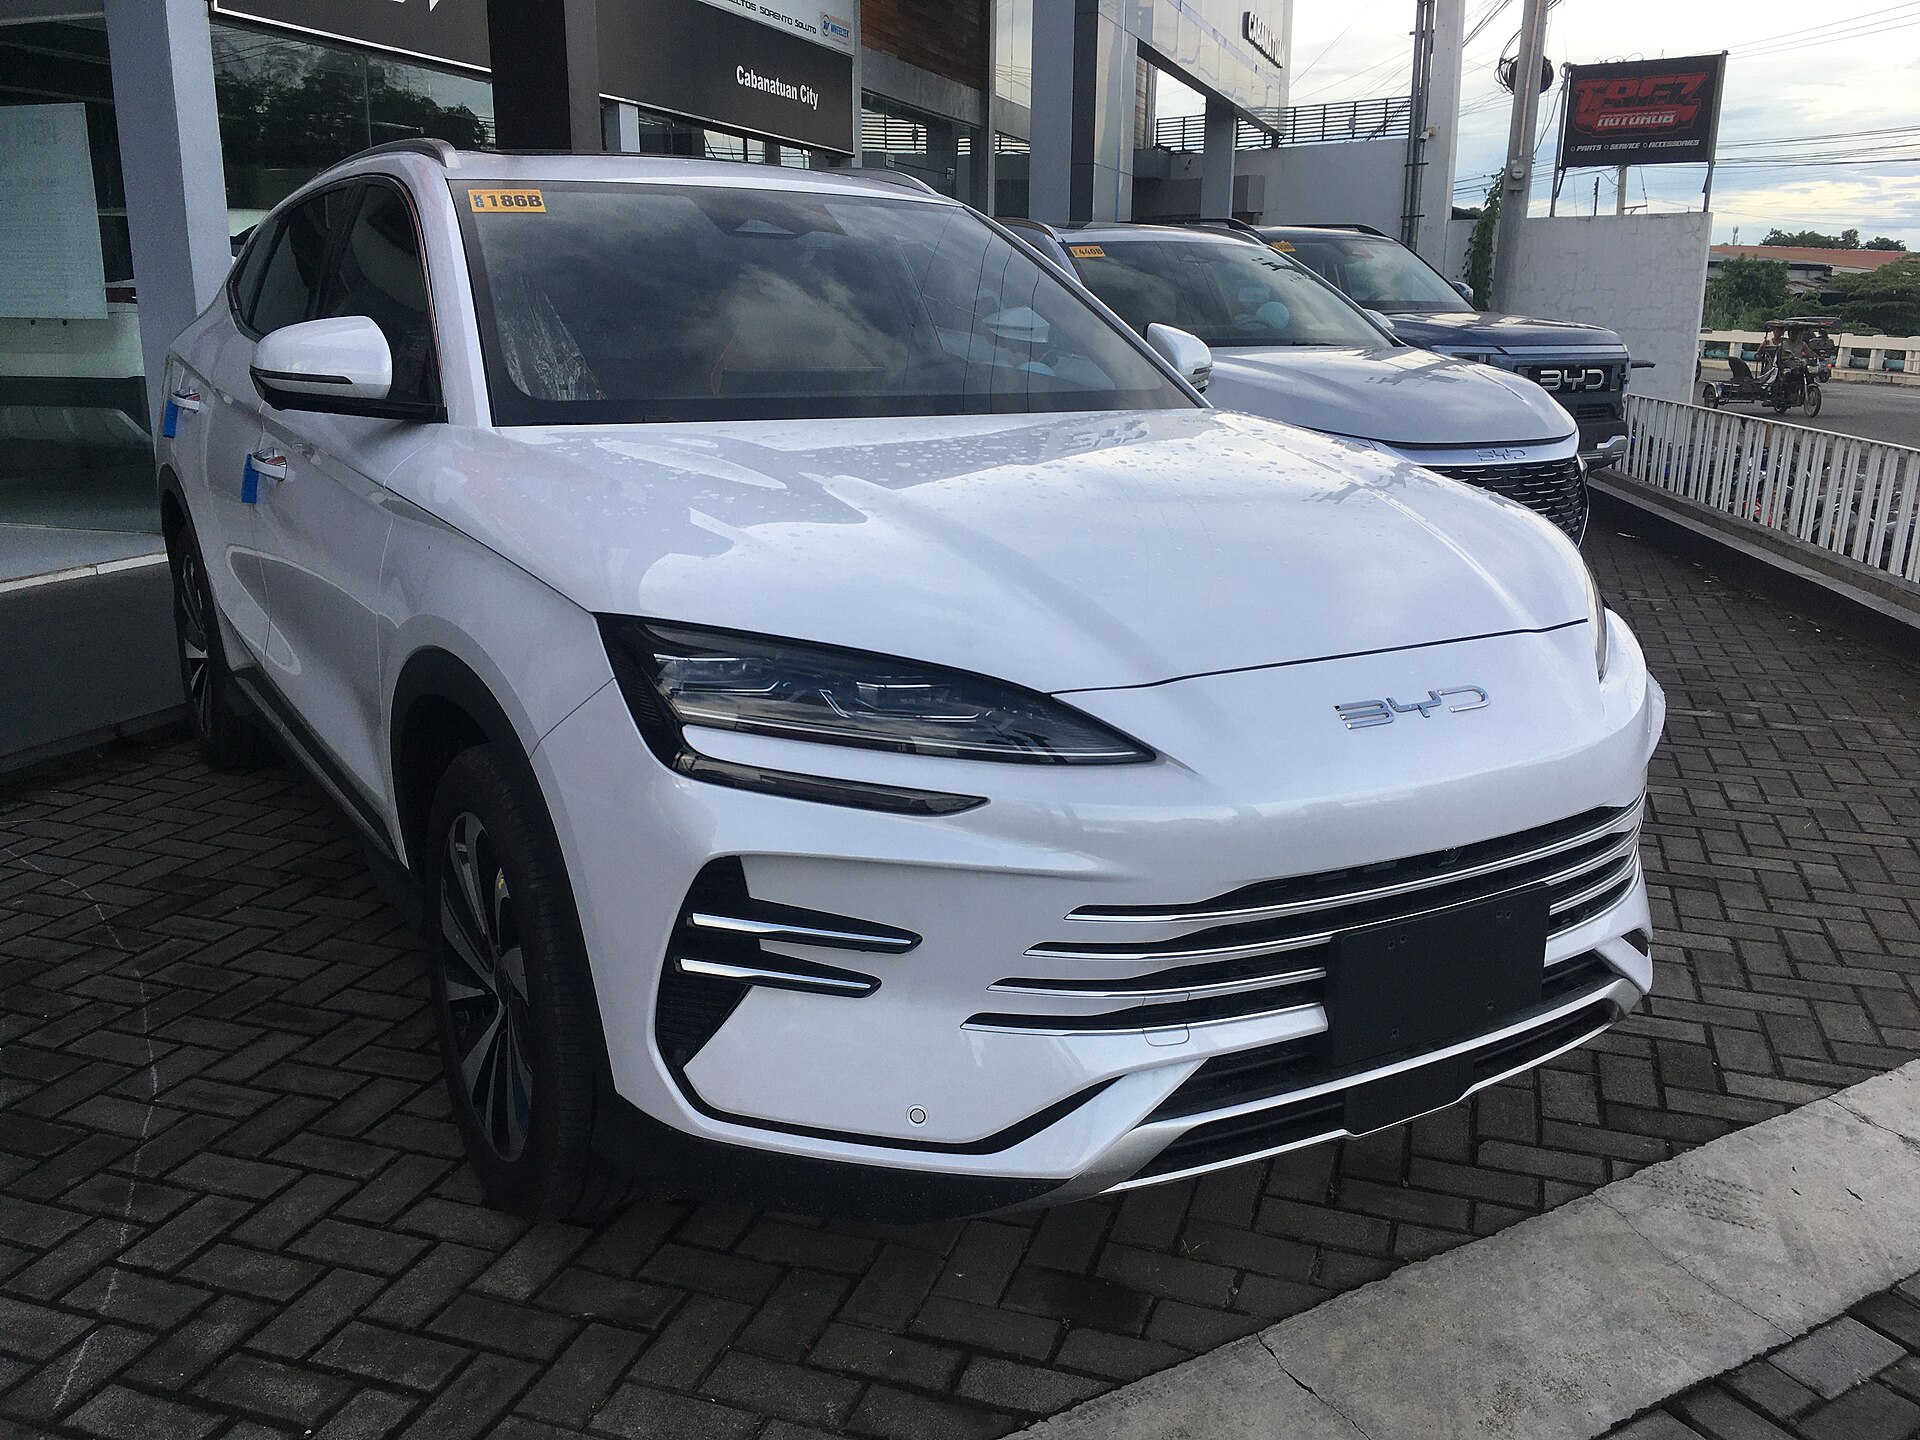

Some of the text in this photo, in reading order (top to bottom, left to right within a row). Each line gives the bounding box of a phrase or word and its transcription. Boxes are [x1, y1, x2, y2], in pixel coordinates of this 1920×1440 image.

[728, 0, 756, 11] LTOS
[760, 6, 793, 25] SORENTO
[736, 65, 819, 110] Cabanatuan City
[1576, 139, 1700, 152] PARTS SERVICE ACCESSORIES
[487, 195, 542, 207] 186B
[1540, 369, 1605, 391] BYD
[1475, 448, 1526, 462] BYD
[1334, 684, 1491, 730] BYD
